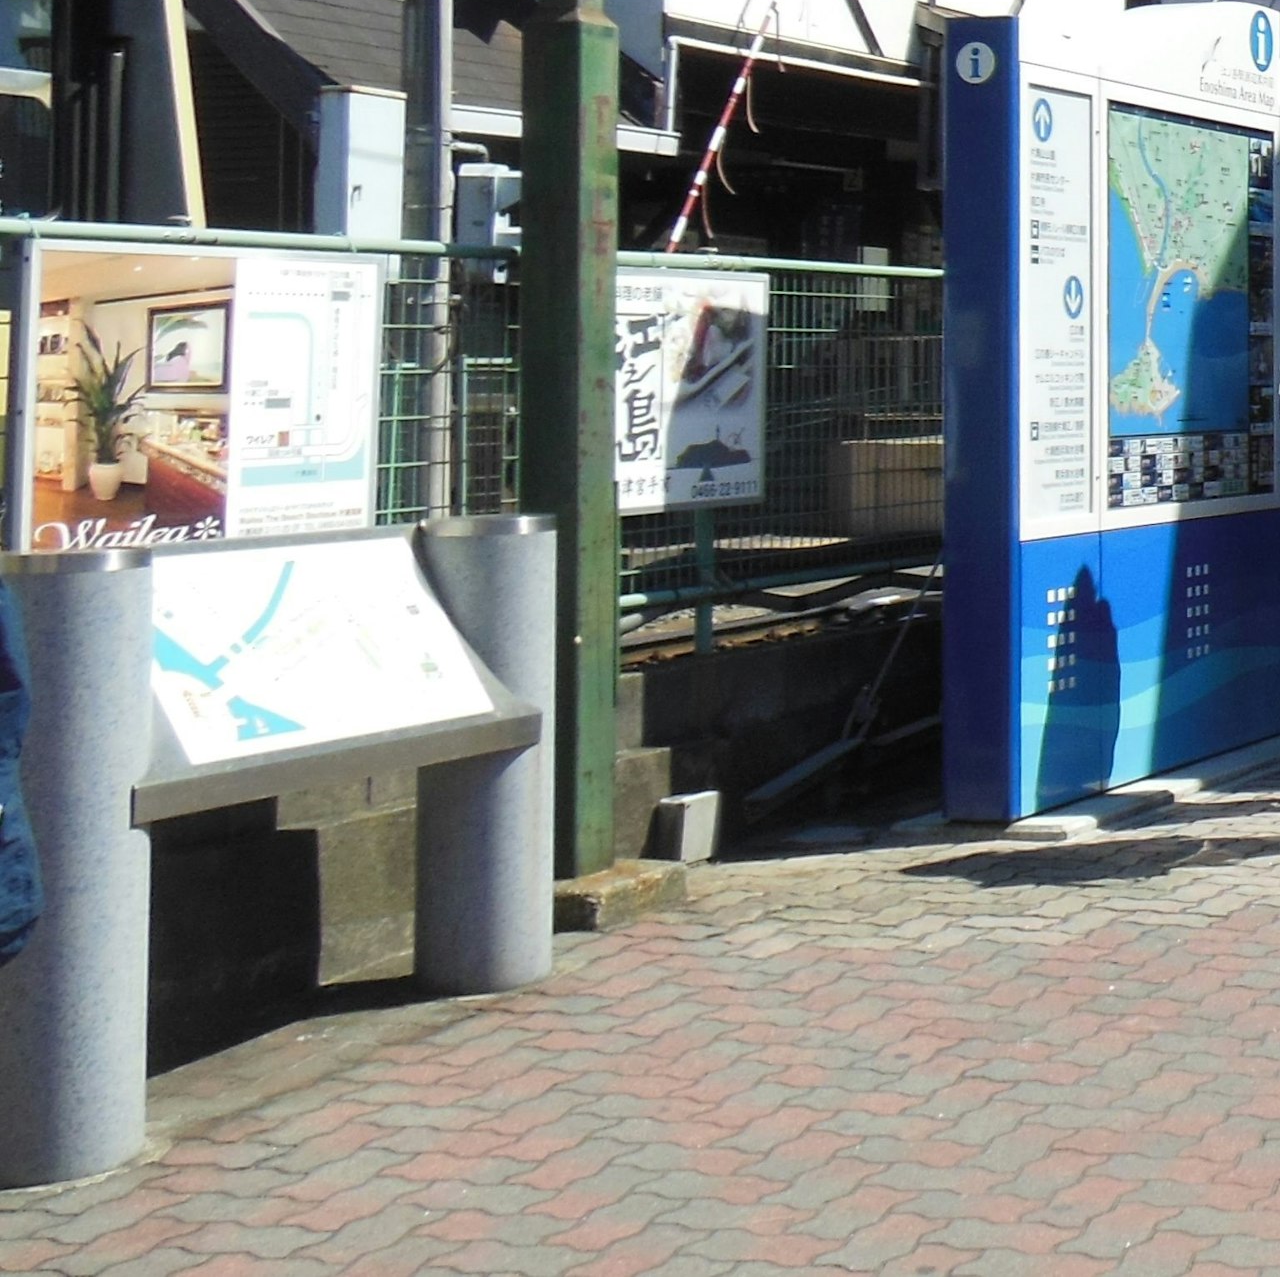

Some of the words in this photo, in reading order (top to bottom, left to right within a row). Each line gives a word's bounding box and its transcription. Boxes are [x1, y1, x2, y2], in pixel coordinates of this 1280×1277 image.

[1199, 76, 1238, 101] Enoshima
[1239, 87, 1258, 105] Area
[1258, 91, 1275, 112] Map
[34, 513, 192, 553] Wailea
